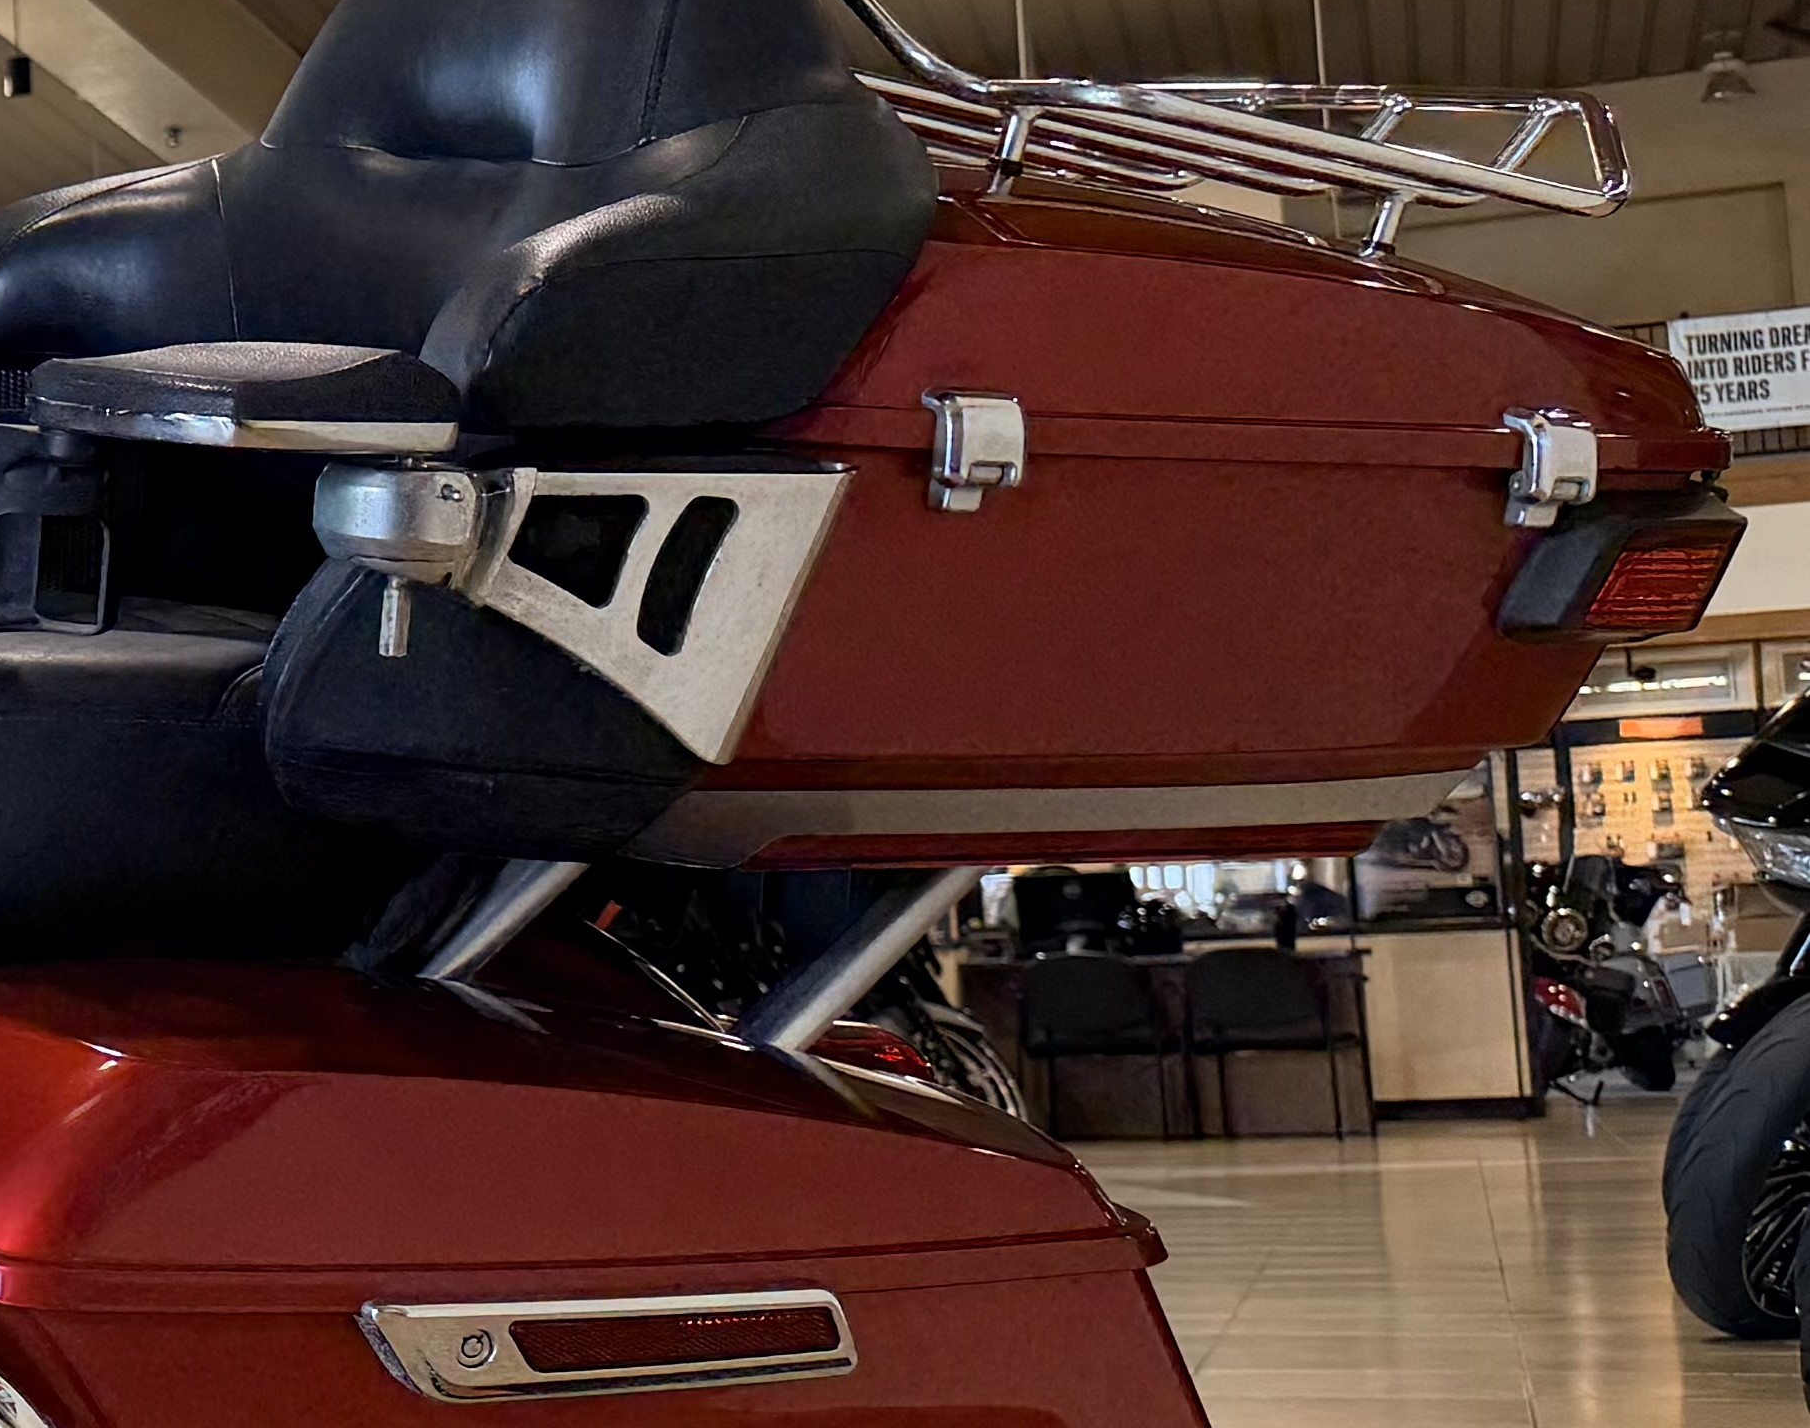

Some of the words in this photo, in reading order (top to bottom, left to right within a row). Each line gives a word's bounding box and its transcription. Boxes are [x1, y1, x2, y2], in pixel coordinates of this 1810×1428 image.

[1685, 328, 1765, 356] TURNING
[1687, 357, 1729, 381] INTO
[1733, 351, 1797, 376] RIDERS
[1714, 378, 1771, 404] YEARS
